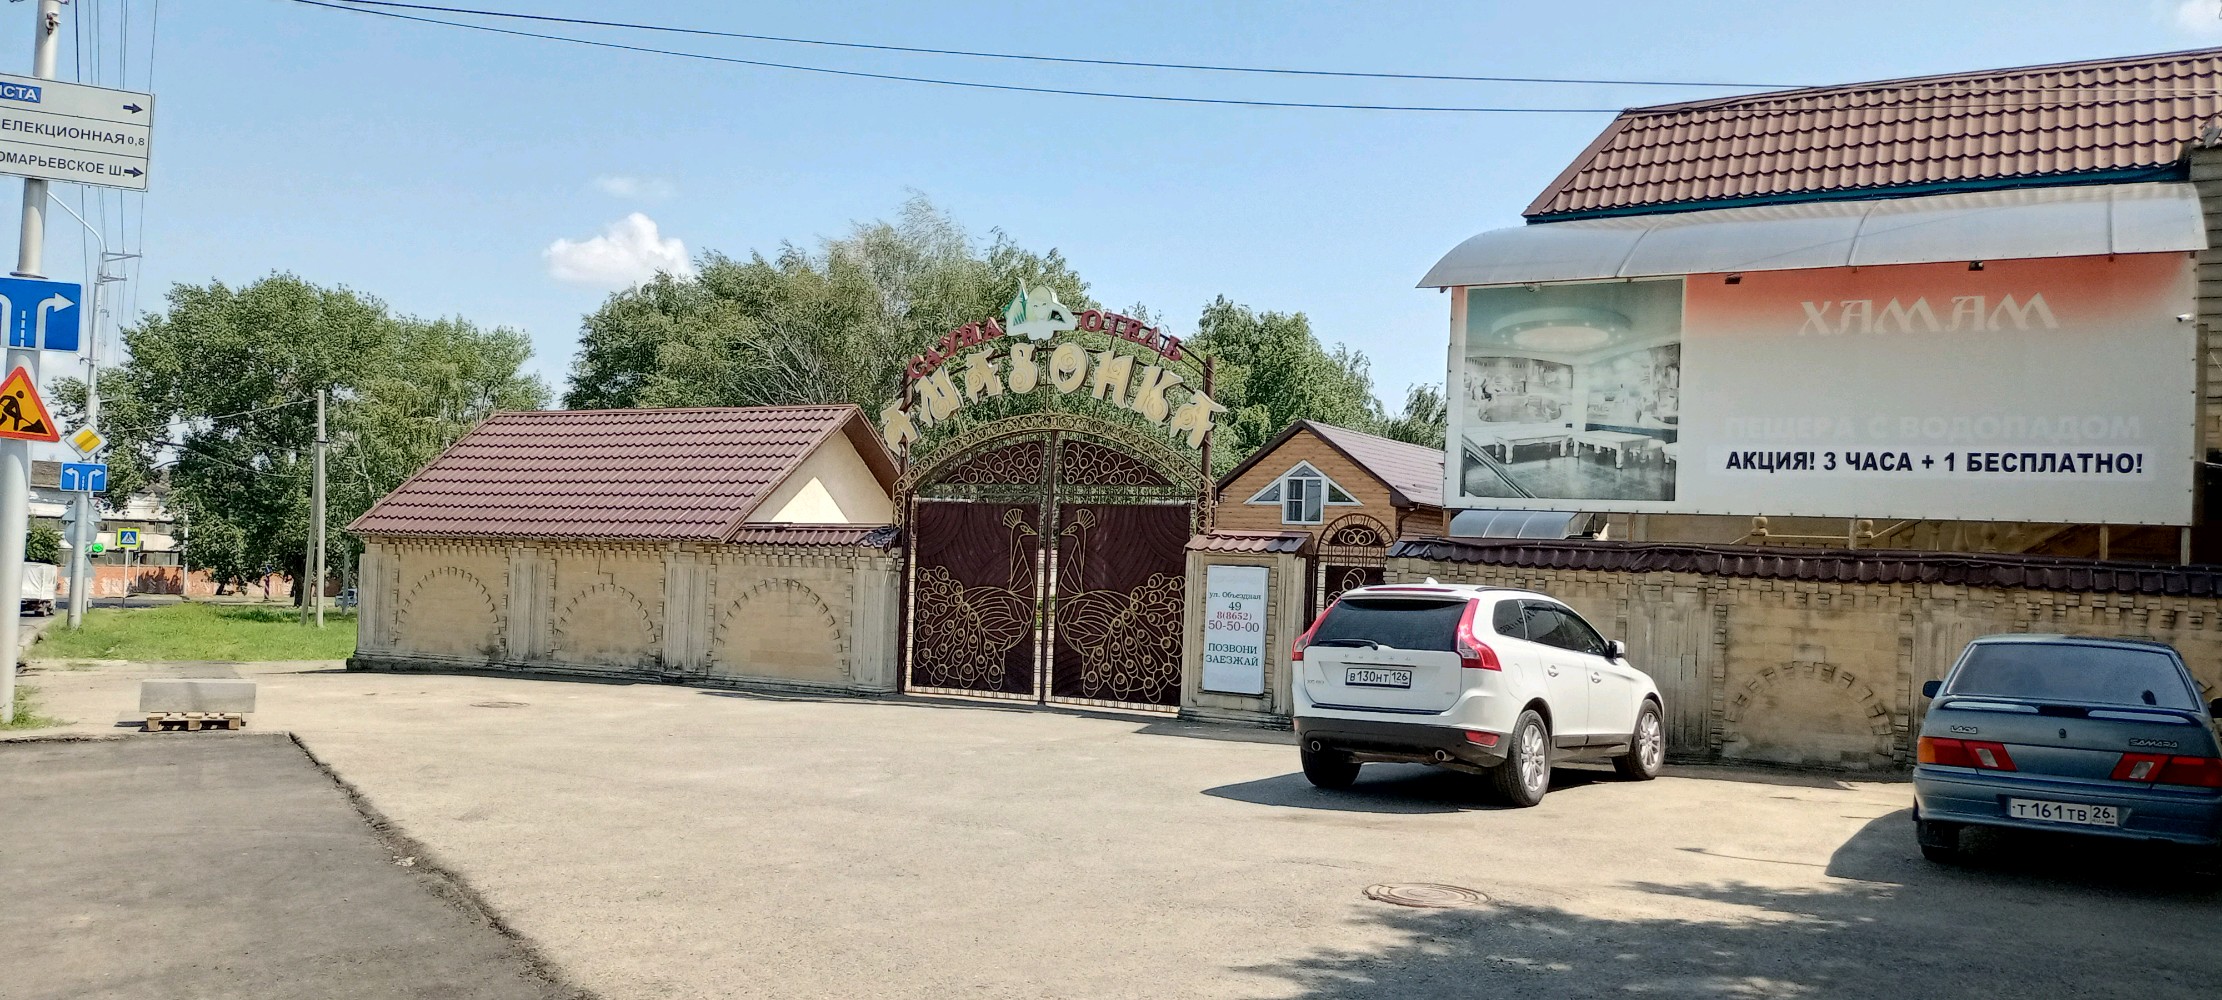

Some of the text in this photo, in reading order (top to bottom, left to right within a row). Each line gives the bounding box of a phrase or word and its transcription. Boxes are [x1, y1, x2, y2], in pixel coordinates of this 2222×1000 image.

[127, 136, 145, 147] 0,8
[1797, 291, 2060, 336] ХАМАМ
[907, 309, 1183, 379] САУНА ОТЕЛЬ
[879, 342, 1229, 456] АМАЗОНКА
[1725, 415, 1855, 441] ПЕЩЕРА
[1900, 414, 2142, 443] ВОДОПАДОМ
[1726, 450, 2143, 474] АКЦИЯ! 3 ЧАСА + 1 БЕСПЛАТНО!
[1228, 602, 1242, 611] 49
[1217, 611, 1252, 621] 8(8652)
[1208, 620, 1260, 633] 50-50-00
[1208, 643, 1257, 654] ПОЗВОНИ
[1206, 654, 1258, 667] ЗАЕЗЖАЙ
[2093, 806, 2111, 819] 26
